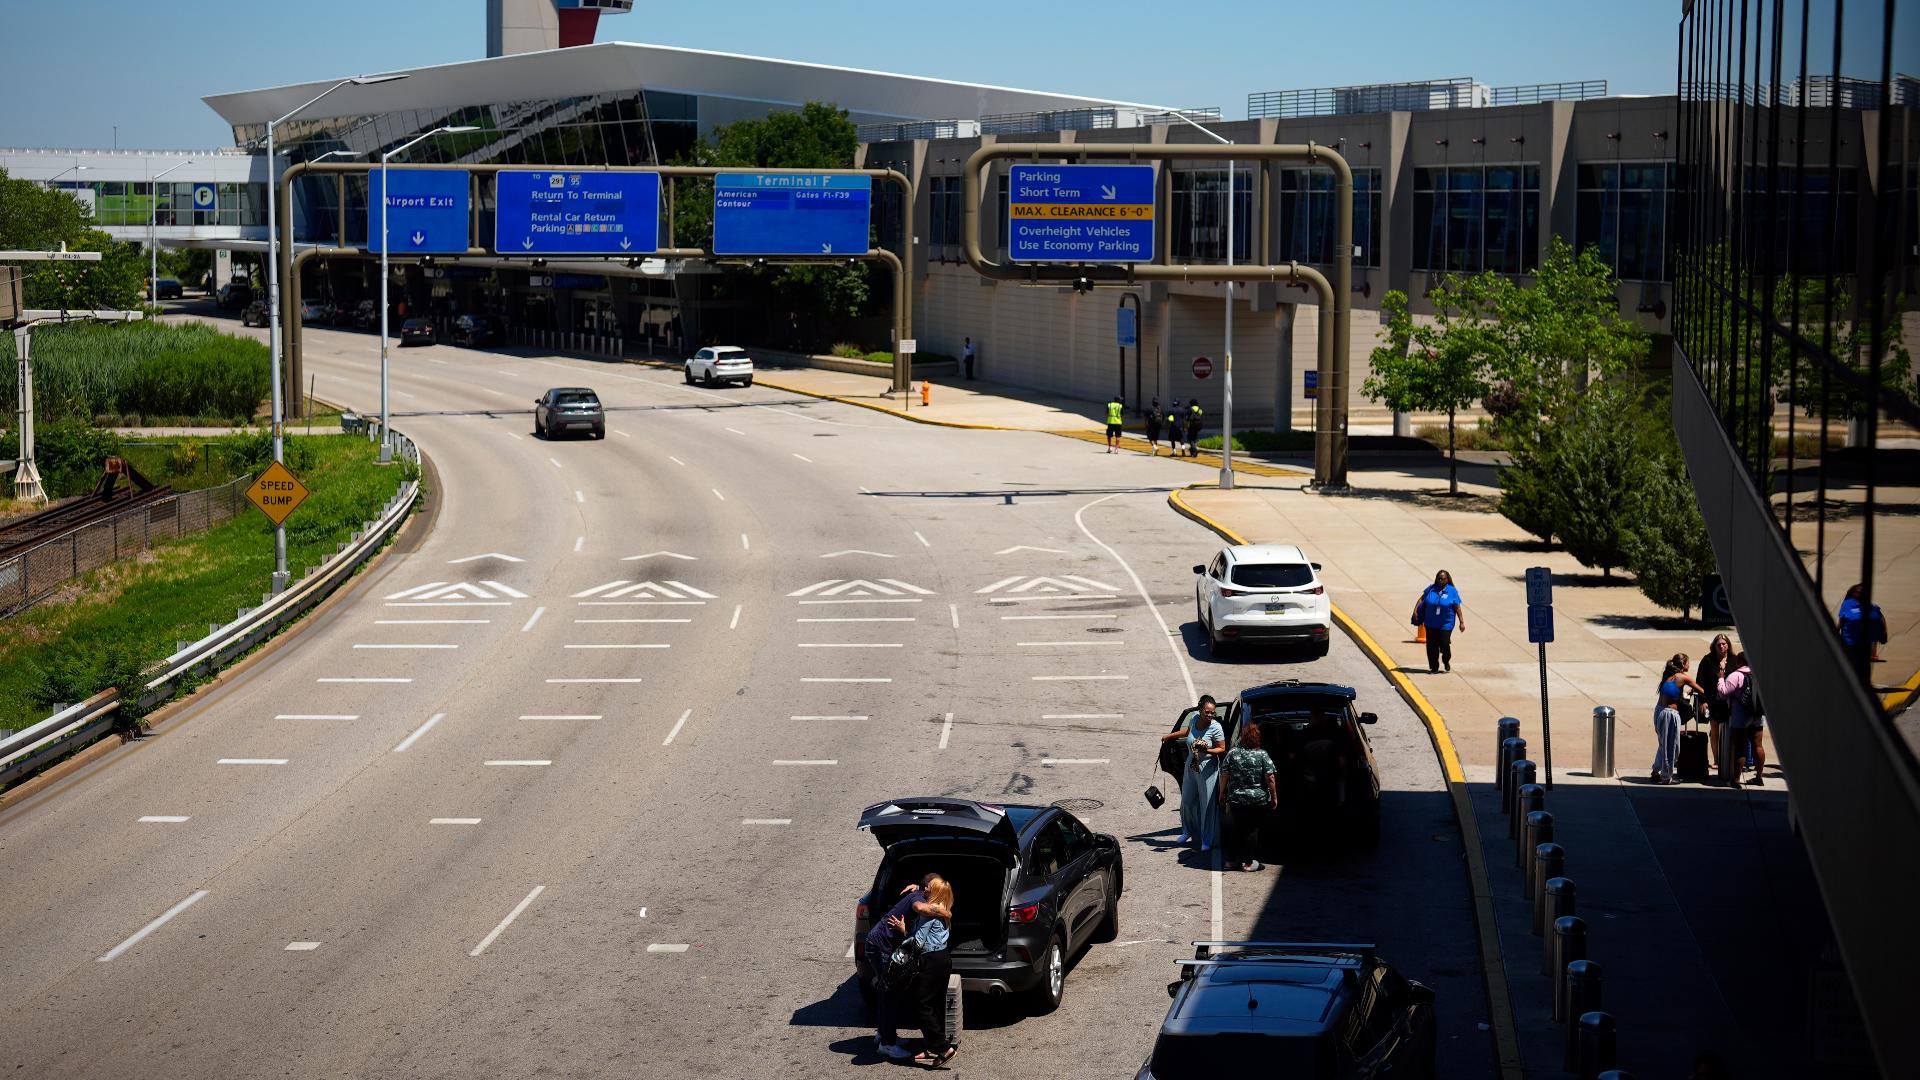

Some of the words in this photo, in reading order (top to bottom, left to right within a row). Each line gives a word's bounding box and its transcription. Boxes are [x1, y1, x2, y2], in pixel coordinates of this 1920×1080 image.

[551, 177, 564, 185] 291
[570, 177, 580, 186] 95
[756, 175, 817, 187] Terminal
[822, 175, 832, 187] F
[1019, 171, 1061, 184] Parking
[200, 189, 208, 202] F
[531, 190, 564, 199] Return
[567, 190, 579, 199] To
[582, 190, 623, 200] Terminal
[717, 190, 758, 198] American
[795, 191, 819, 199] Gates
[823, 191, 850, 199] F1-F39
[1019, 187, 1049, 197] Short
[1053, 187, 1081, 198] Term
[385, 197, 425, 208] Airport
[429, 197, 454, 207] Exit
[716, 200, 752, 208] Contour
[531, 212, 562, 222] Rental
[565, 213, 581, 222] Car
[584, 212, 616, 222] Return
[1014, 206, 1046, 217] MAX.
[1050, 206, 1116, 217] CLEARANCE
[531, 223, 566, 235] Parking
[1019, 225, 1082, 238] Overheight
[1086, 226, 1130, 237] Vehicles
[1019, 240, 1040, 250] Use
[1044, 240, 1094, 252] Economy
[1098, 240, 1140, 253] Parking
[260, 481, 294, 491] SPEED
[262, 496, 293, 505] BUMP
